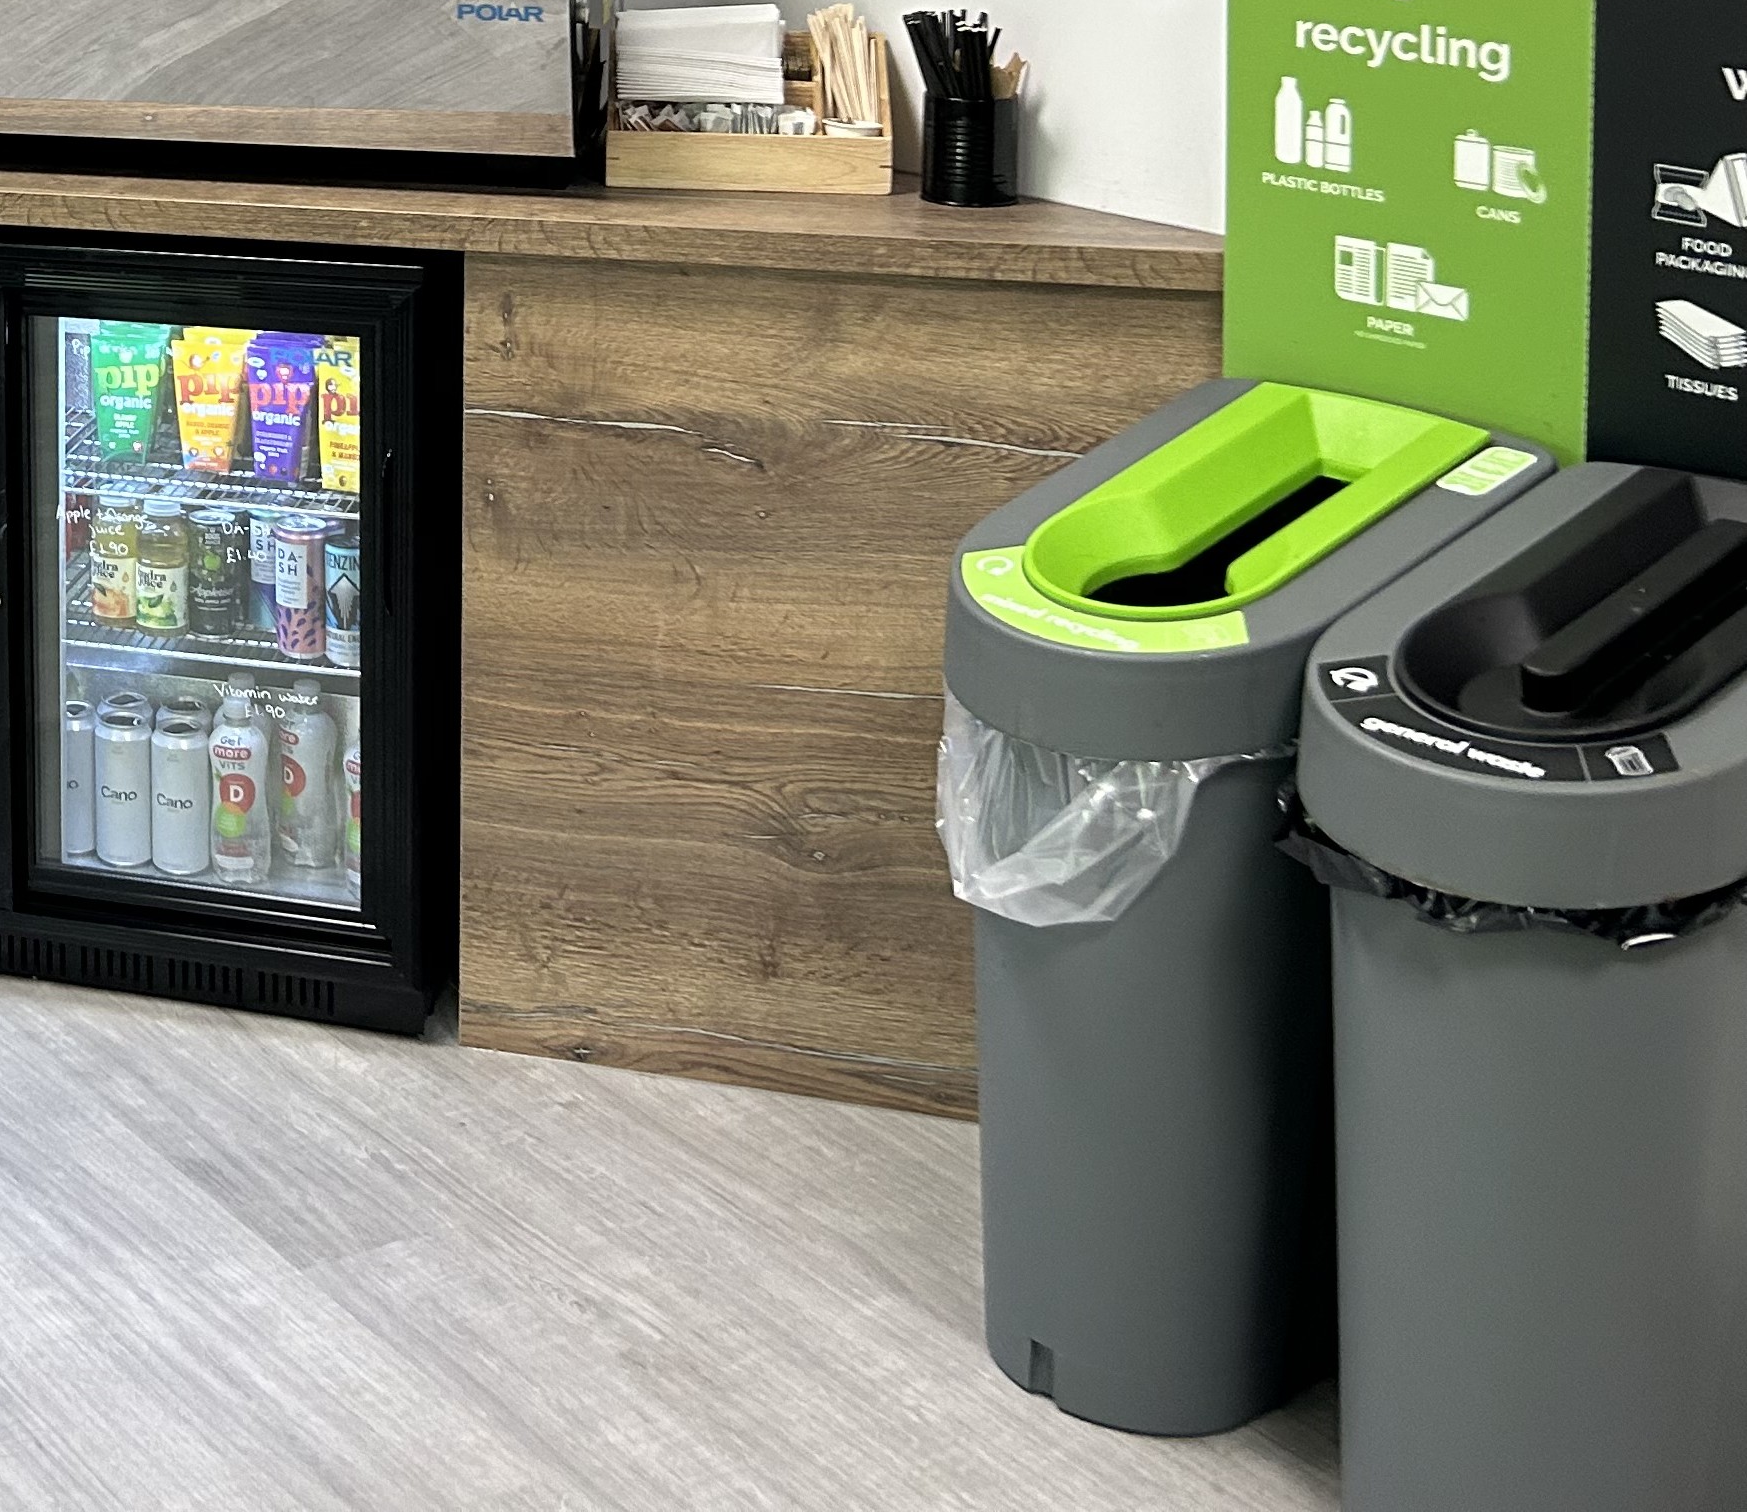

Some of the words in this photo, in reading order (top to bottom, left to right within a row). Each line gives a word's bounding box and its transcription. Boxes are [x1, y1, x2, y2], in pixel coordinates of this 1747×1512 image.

[456, 3, 545, 22] POLAR
[1295, 19, 1511, 82] recycling
[1262, 171, 1318, 192] PLASTIC
[1320, 182, 1386, 203] BOTTLES
[1475, 205, 1522, 224] CANS
[1681, 237, 1733, 258] FOOD
[1655, 252, 1747, 280] PACKAGIN
[1366, 316, 1414, 336] PAPER
[94, 364, 160, 397] pip
[177, 373, 240, 405] pip
[1664, 373, 1738, 402] TISSUES
[99, 394, 153, 411] organic
[249, 381, 310, 415] pip
[321, 392, 360, 425] pi
[181, 402, 236, 418] organic
[252, 410, 301, 426] organic
[279, 562, 298, 577] SH
[1046, 614, 1140, 652] recycling
[213, 683, 272, 701] Vitamin
[278, 692, 320, 706] water
[214, 746, 250, 760] more
[1359, 717, 1470, 755] general
[1466, 747, 1546, 778] waste
[101, 785, 138, 802] Cano
[156, 792, 193, 810] Cano
[229, 784, 244, 803] D
